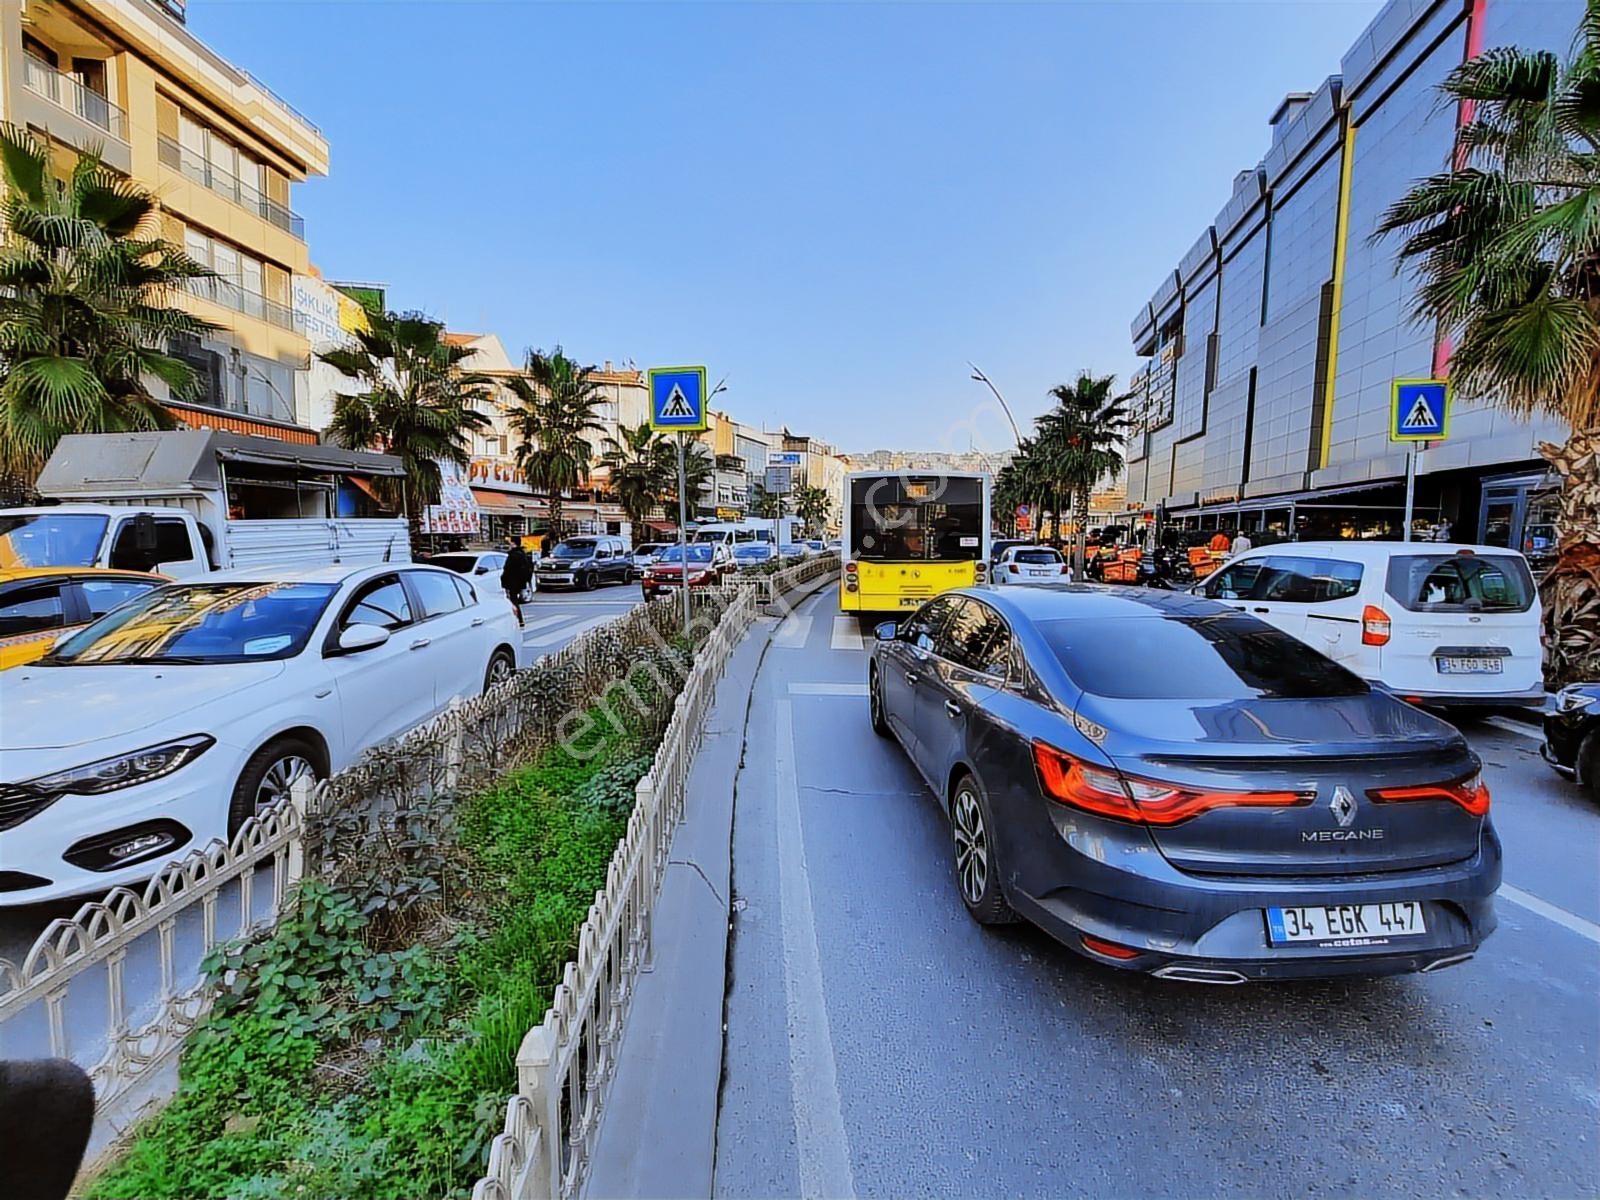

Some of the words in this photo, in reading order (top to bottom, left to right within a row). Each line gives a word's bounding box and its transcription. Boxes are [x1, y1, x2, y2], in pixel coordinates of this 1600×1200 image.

[1302, 829, 1384, 842] MEGANE
[1285, 908, 1314, 936] 34
[1325, 905, 1368, 935] EGK
[1379, 902, 1414, 932] 447
